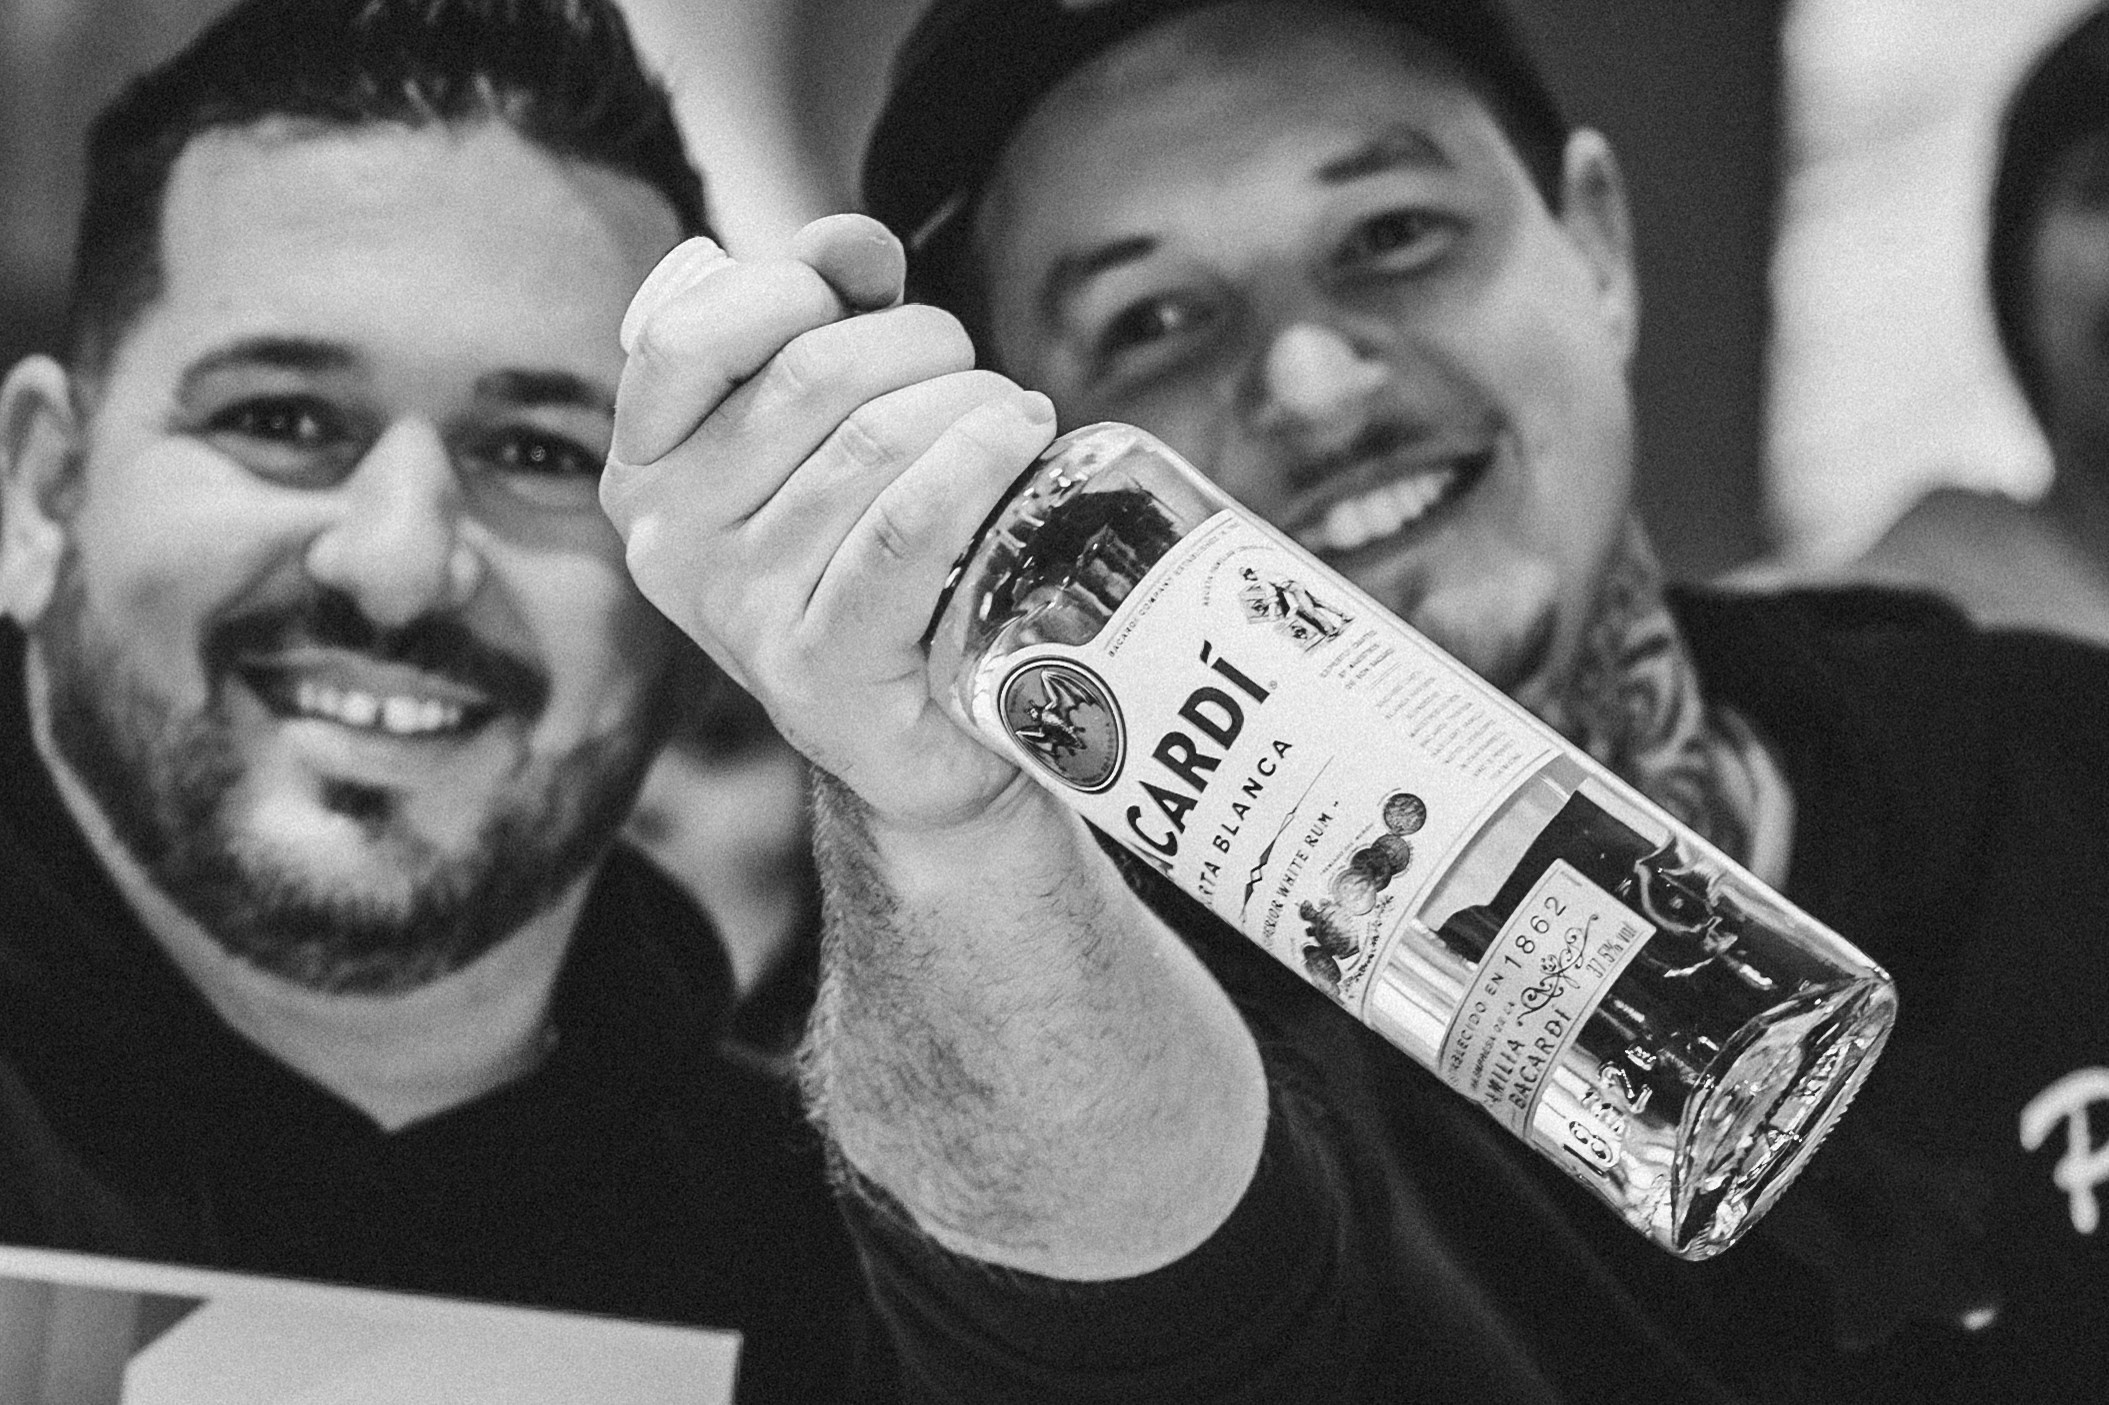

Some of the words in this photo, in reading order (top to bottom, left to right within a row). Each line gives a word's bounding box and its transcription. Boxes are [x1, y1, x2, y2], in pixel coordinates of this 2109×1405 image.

[1211, 739, 1293, 854] BLANCA
[1275, 848, 1309, 898] WHITE
[1303, 811, 1333, 848] RUM
[1483, 971, 1505, 996] EN
[1503, 895, 1567, 969] 1862
